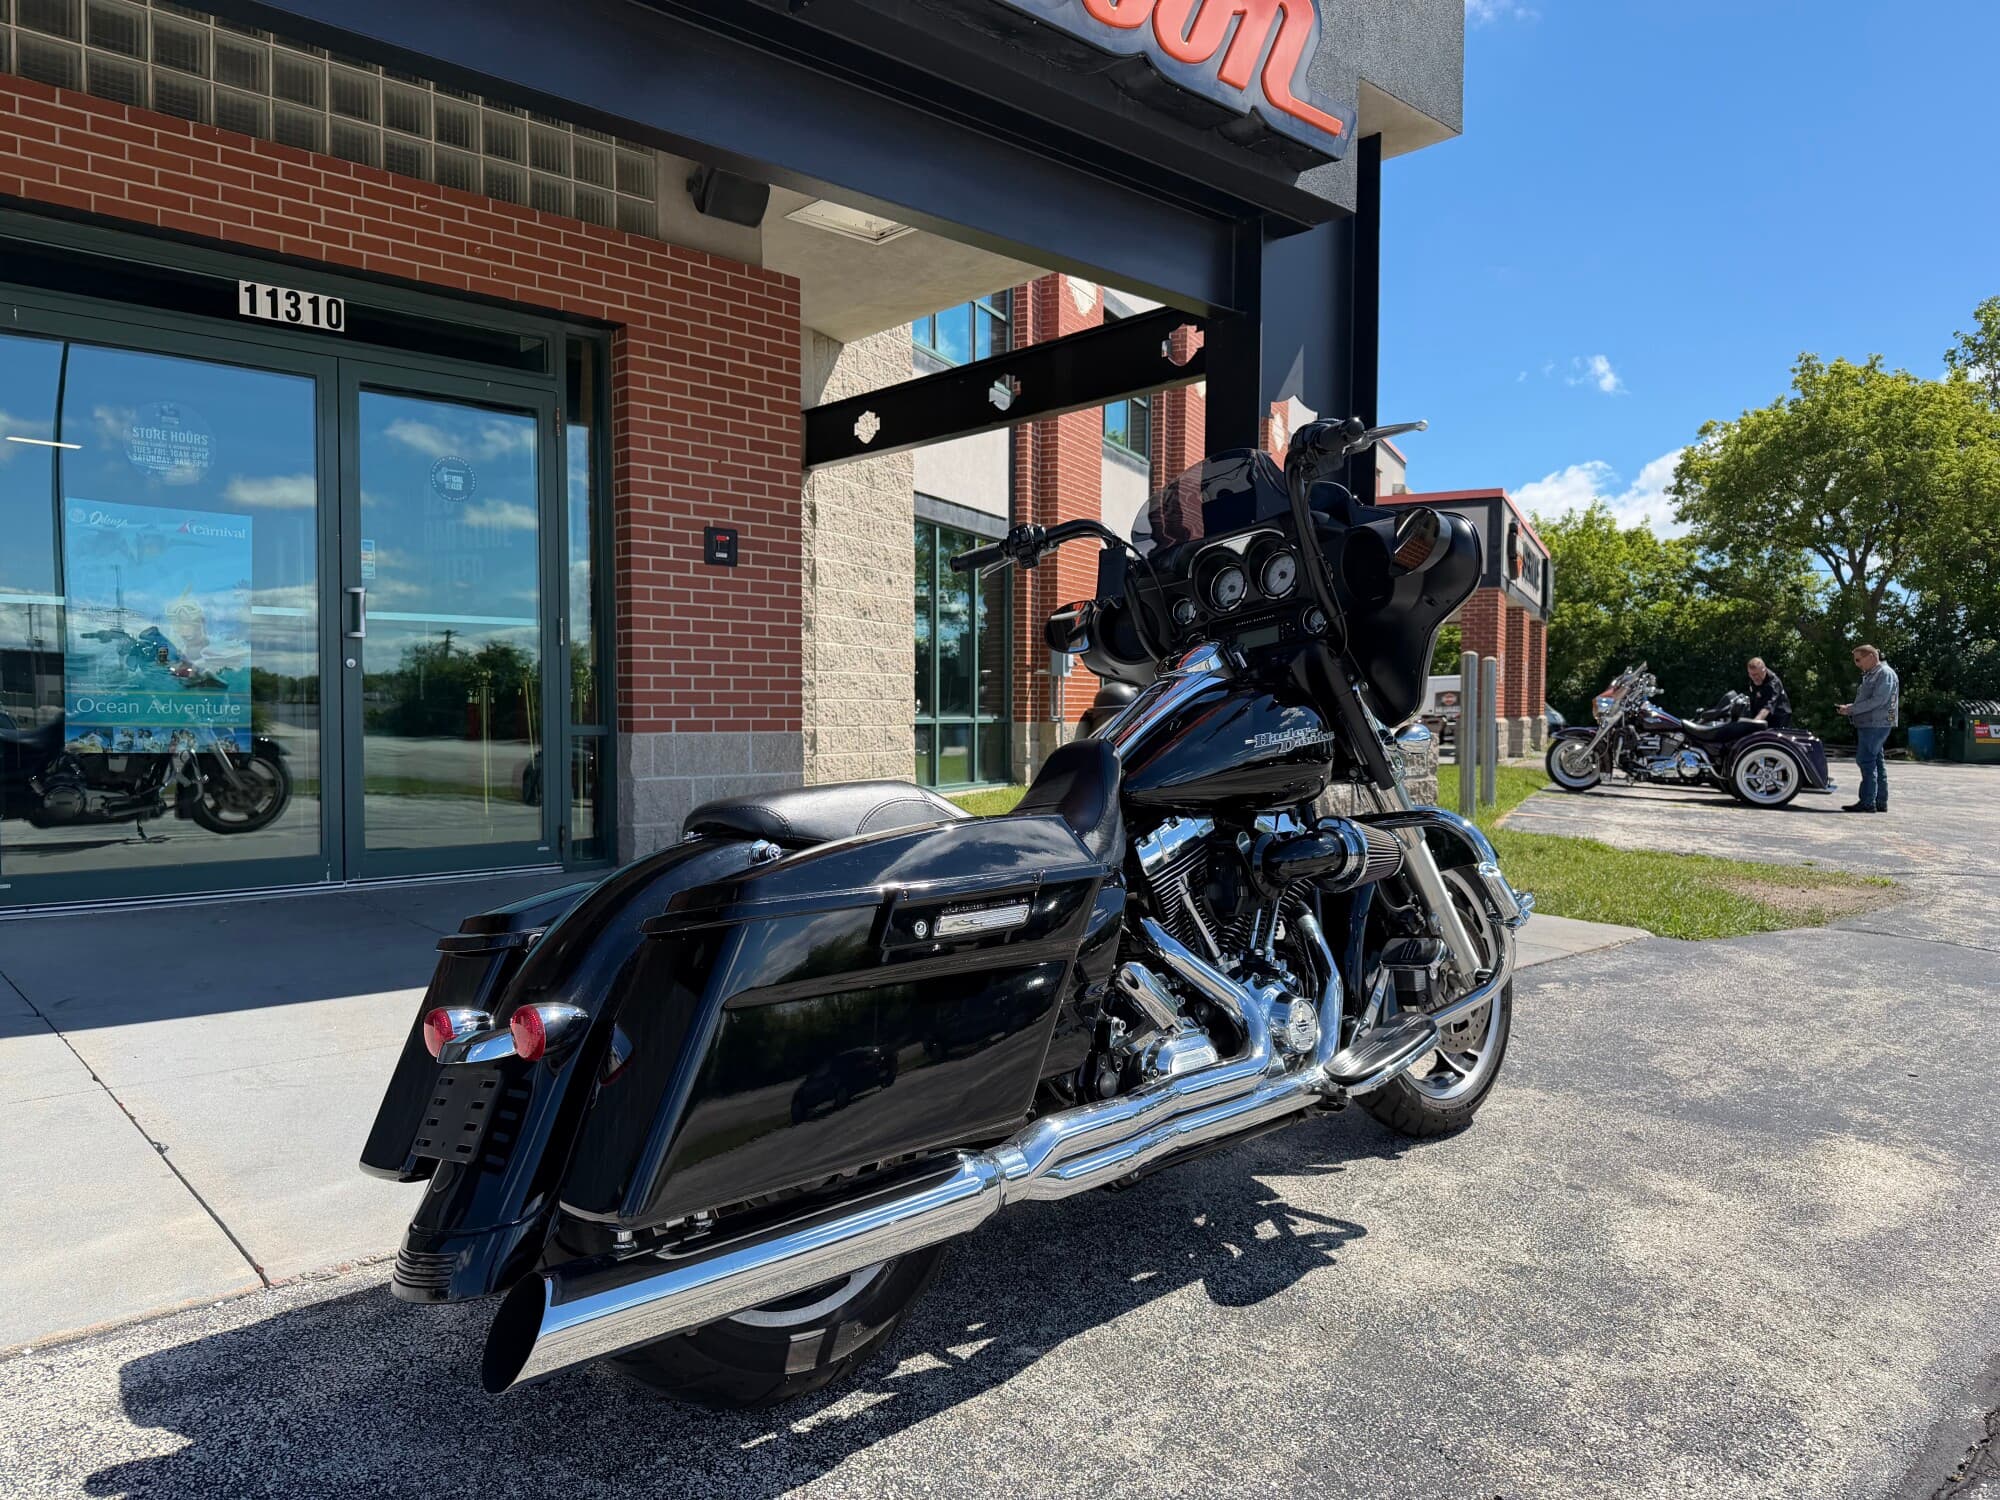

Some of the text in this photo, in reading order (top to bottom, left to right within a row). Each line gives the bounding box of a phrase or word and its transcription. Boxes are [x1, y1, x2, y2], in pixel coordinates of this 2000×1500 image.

[244, 284, 342, 329] 11310
[132, 426, 167, 441] STORE
[170, 431, 209, 446] HOURS
[192, 524, 246, 539] Carnival
[76, 697, 241, 716] Ocean Adventure
